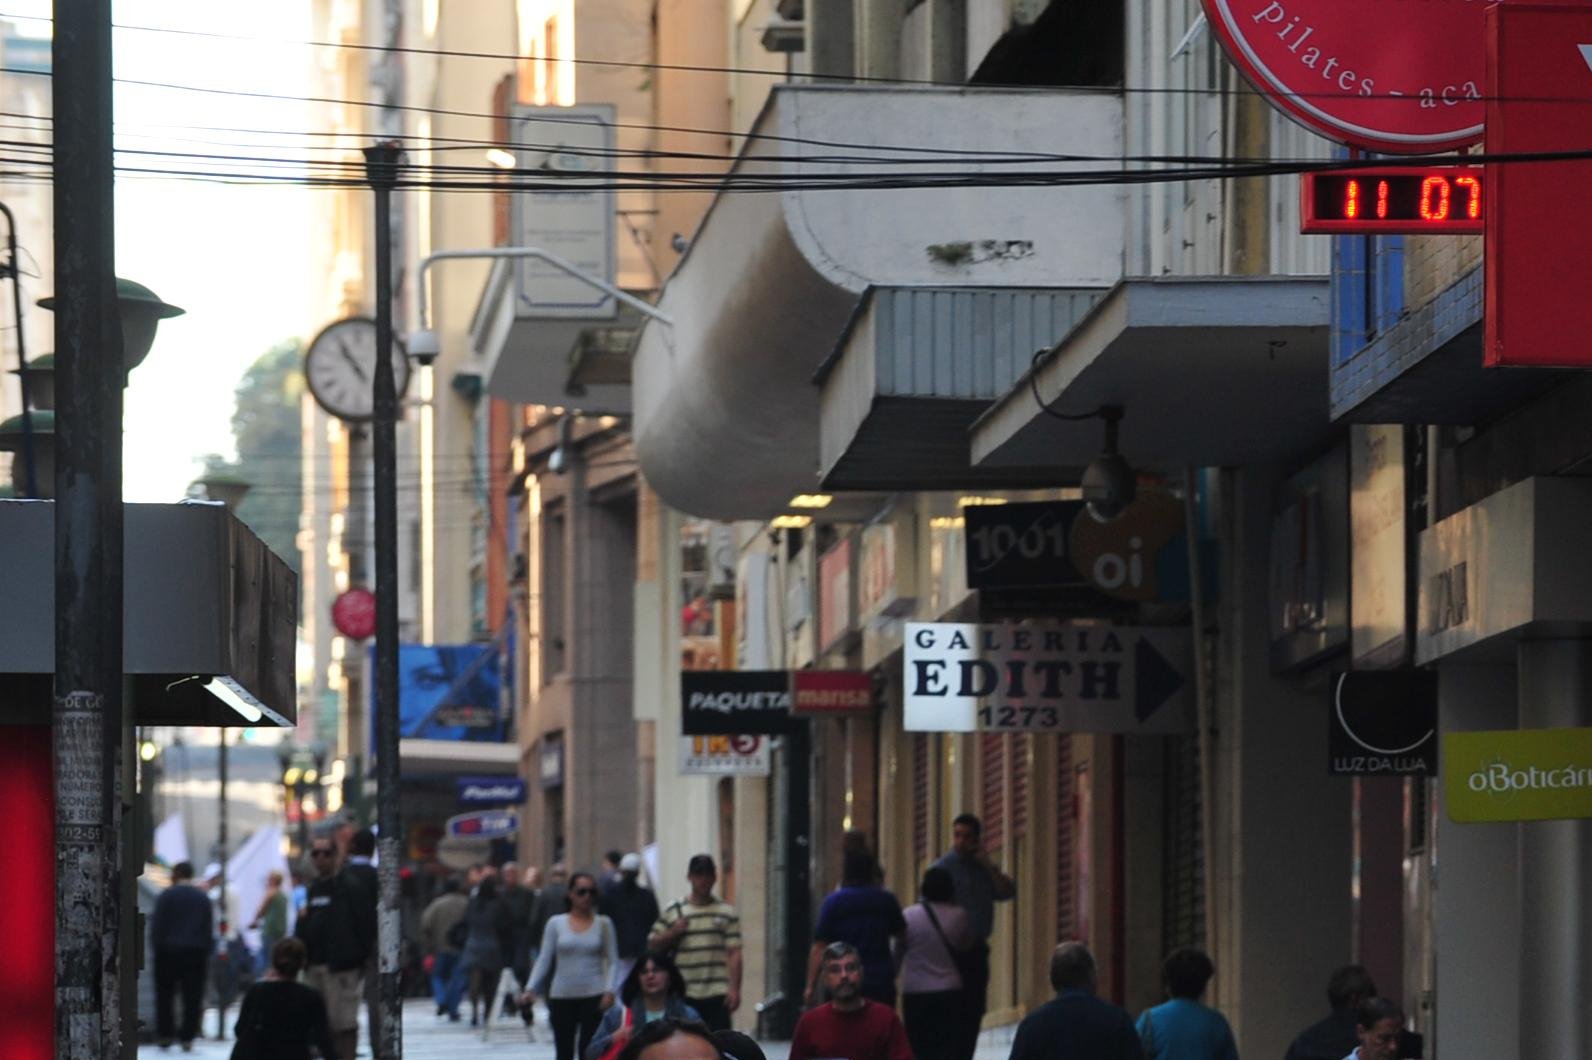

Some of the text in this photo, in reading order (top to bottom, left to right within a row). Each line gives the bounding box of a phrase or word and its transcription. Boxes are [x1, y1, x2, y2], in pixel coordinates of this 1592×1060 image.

[1252, 1, 1483, 109] pilates aca
[1344, 175, 1483, 220] 11 07
[971, 520, 1066, 563] 1001
[1093, 535, 1144, 589] oi
[914, 629, 1124, 651] GALERIA
[911, 659, 1123, 699] EDITH
[977, 705, 1059, 728] 1273
[1334, 756, 1426, 772] LUZ DA LUA
